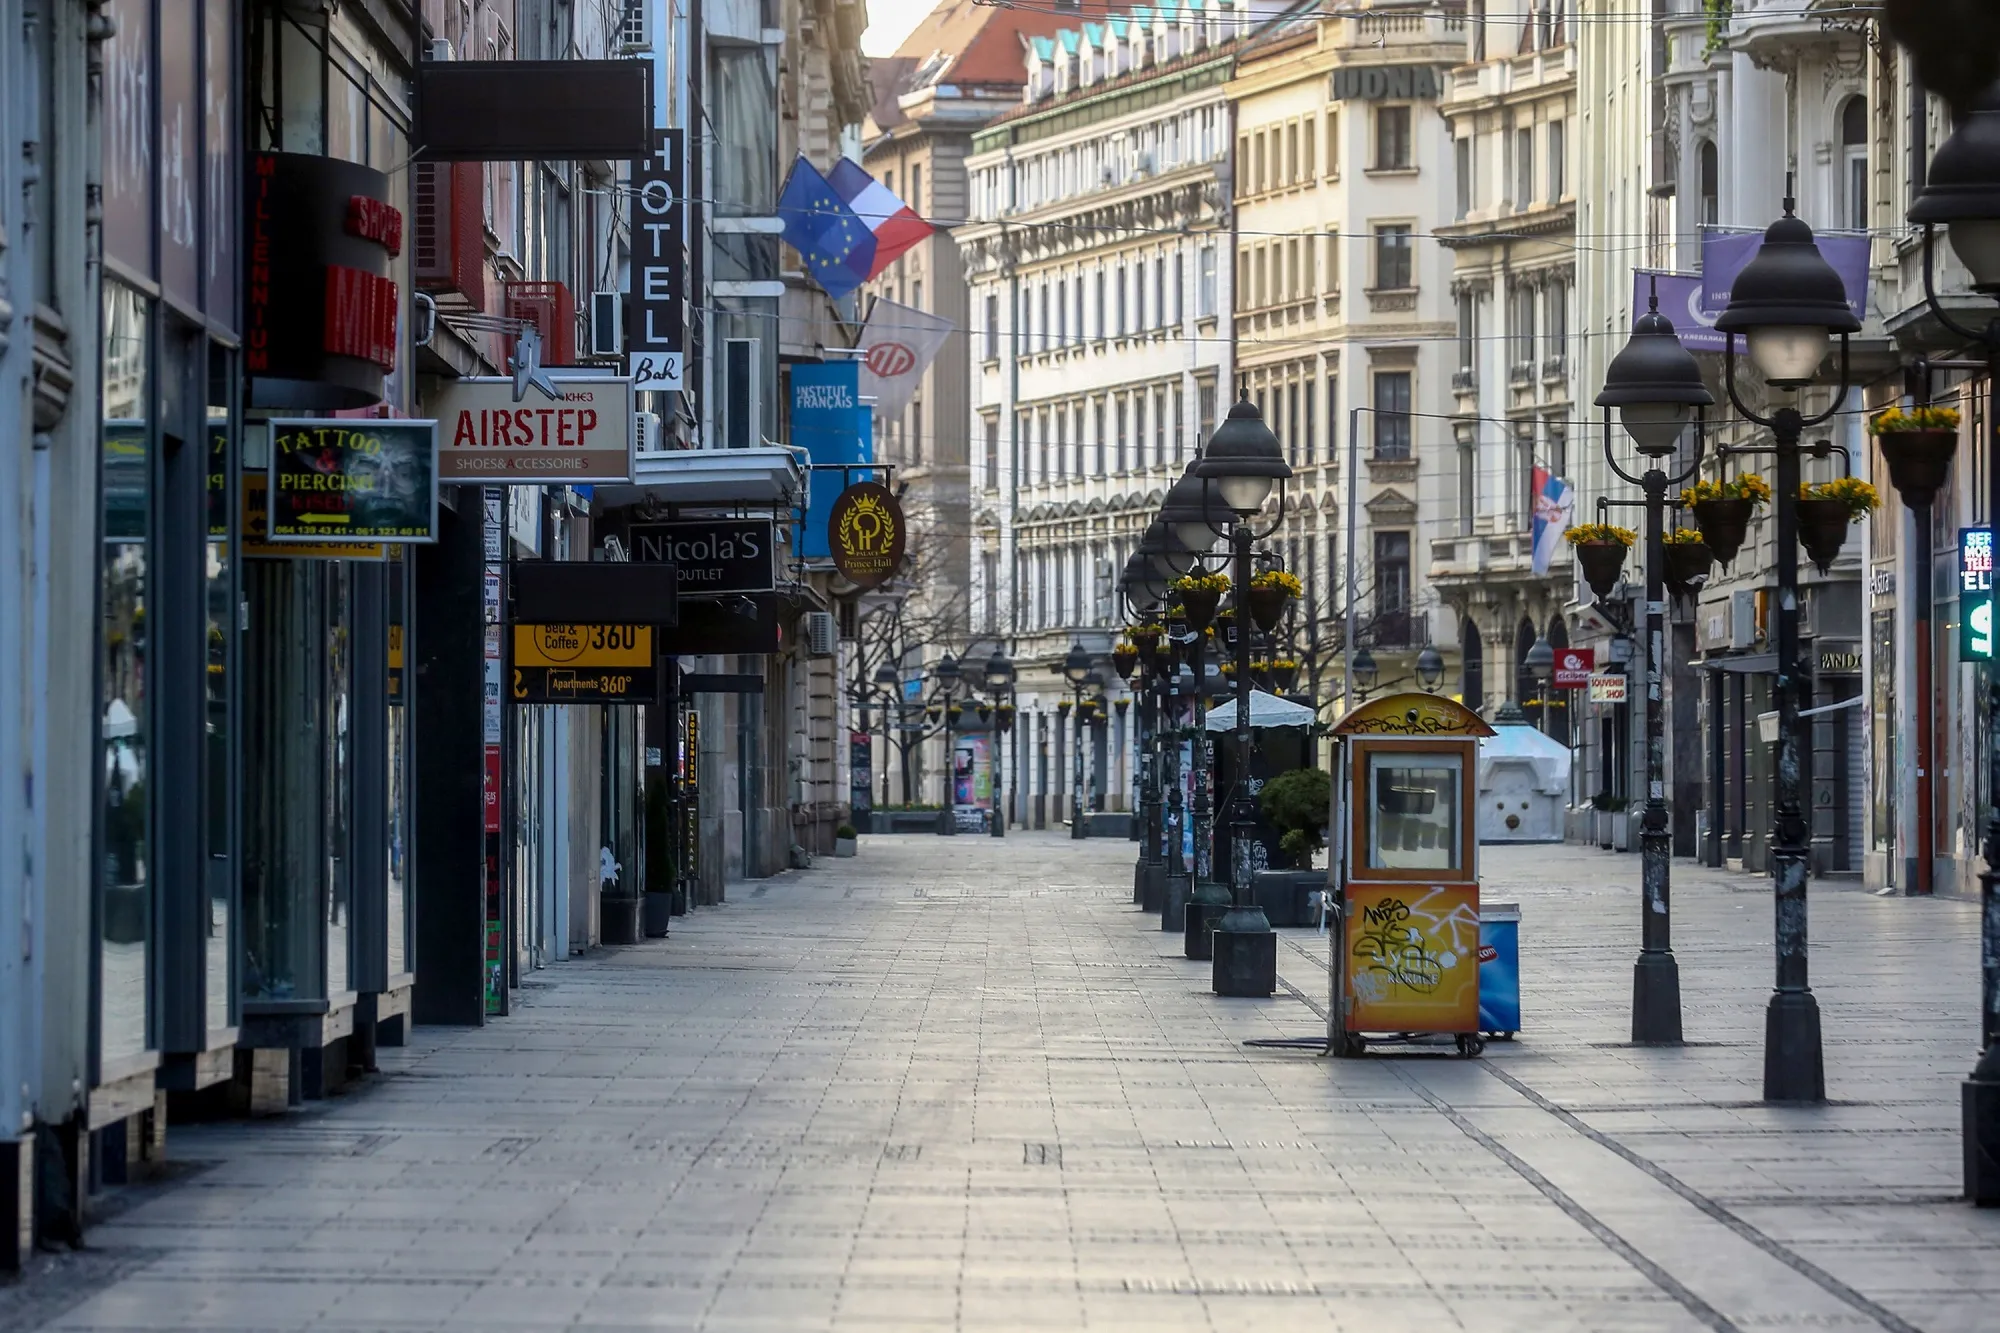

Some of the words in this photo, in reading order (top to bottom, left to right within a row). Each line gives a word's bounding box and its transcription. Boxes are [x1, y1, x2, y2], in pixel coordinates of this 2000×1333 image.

[640, 137, 674, 343] HOTEL
[249, 156, 274, 370] MILLENNIUM
[796, 385, 847, 398] INSTITUT
[453, 409, 597, 447] AIRSTEP
[276, 429, 382, 455] TATTOO
[316, 449, 337, 472] &
[280, 474, 374, 491] PIERCING
[844, 559, 871, 569] Prince
[873, 557, 893, 568] Hall
[677, 568, 724, 581] OUTLET
[545, 636, 579, 650] Coffee
[552, 678, 599, 692] Apartments
[600, 676, 632, 694] 360°
[1591, 678, 1625, 687] SOUVENIR
[1606, 690, 1625, 699] SHOP
